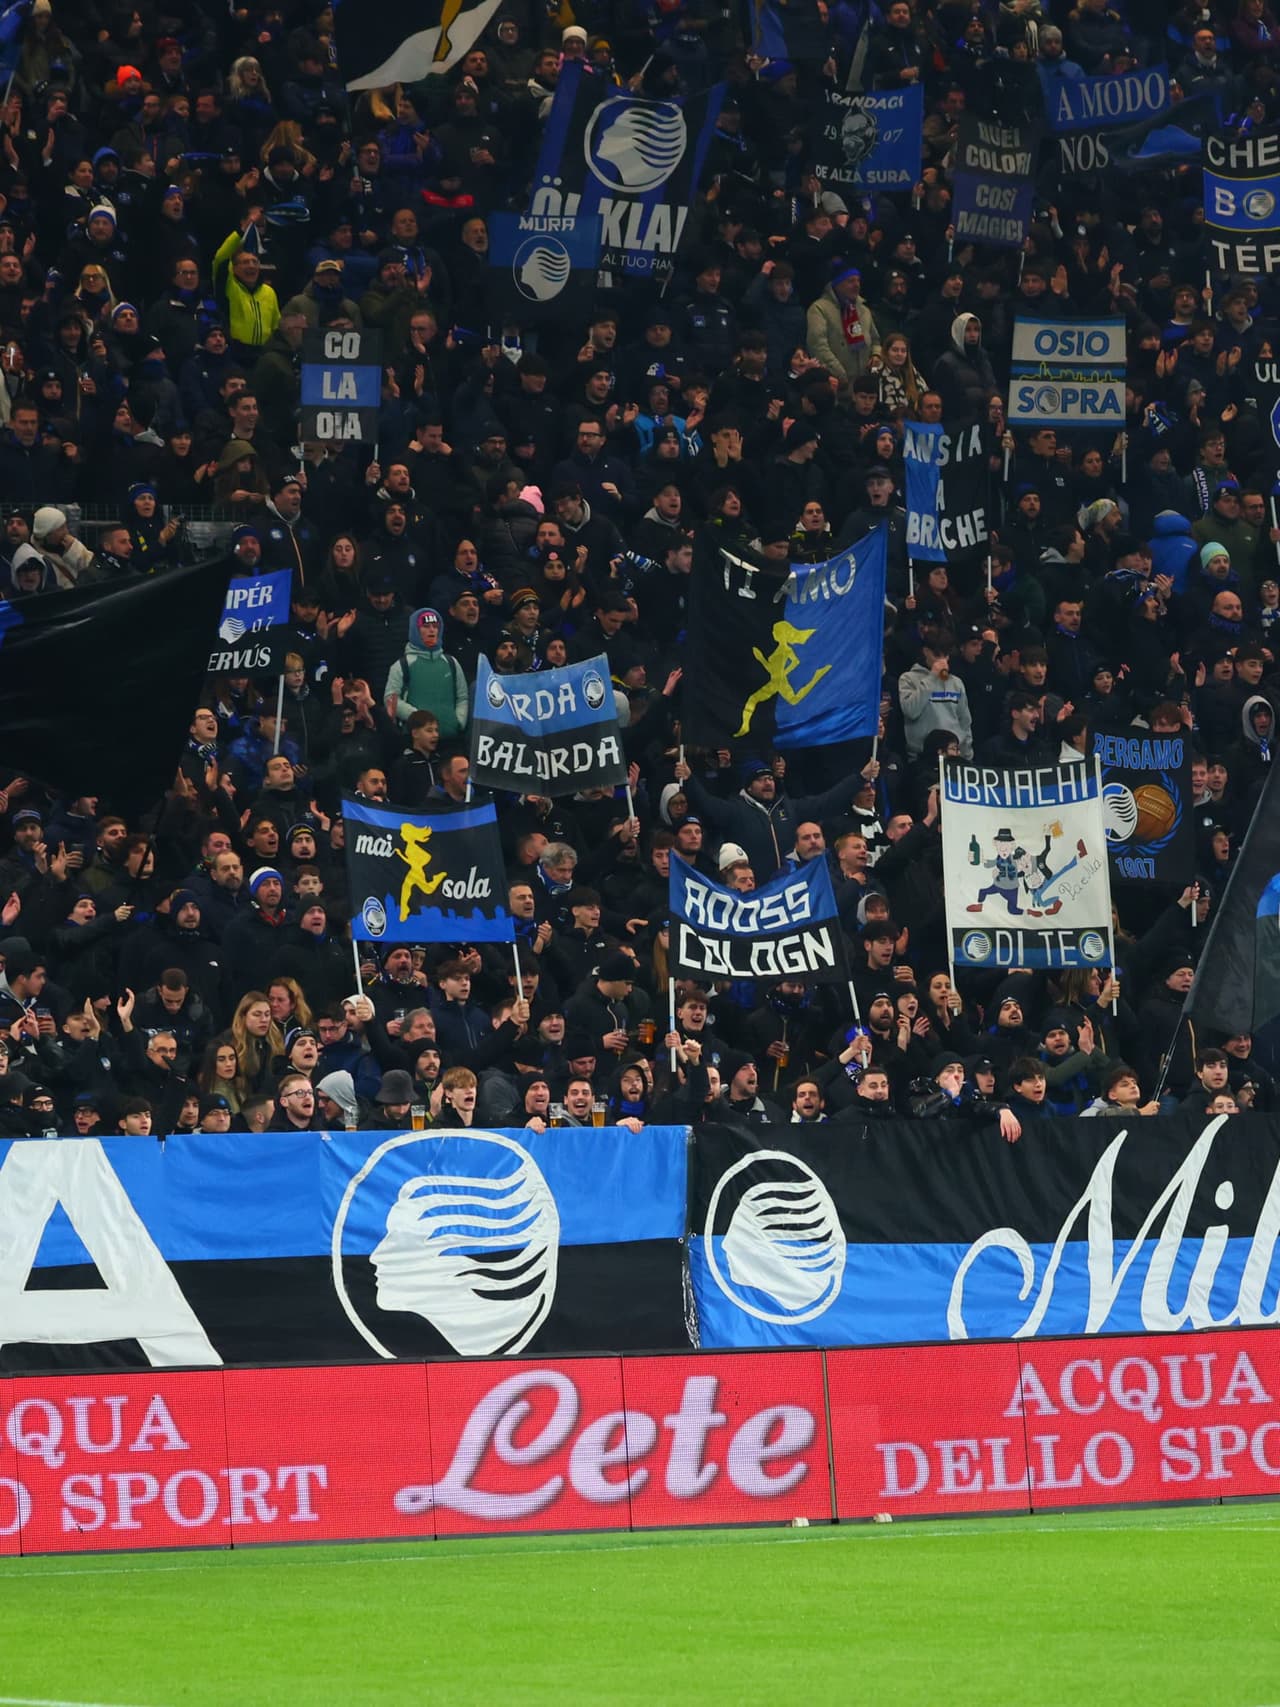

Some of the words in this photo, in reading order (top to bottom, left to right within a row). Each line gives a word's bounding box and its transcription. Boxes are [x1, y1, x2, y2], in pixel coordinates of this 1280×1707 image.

[1057, 86, 1074, 122] A
[1079, 72, 1167, 119] MODO
[866, 169, 911, 184] SURA
[965, 143, 1032, 176] COLORI
[518, 216, 576, 232] MURA
[955, 211, 1024, 244] MAGICI
[620, 255, 647, 269] TUO
[324, 331, 361, 360] CO
[1034, 329, 1110, 357] OSIO
[322, 371, 357, 400] LA
[903, 424, 982, 467] ANSIA
[936, 479, 946, 512] A
[772, 553, 856, 604] AMO
[476, 734, 621, 780] BALORDA
[1092, 732, 1184, 770] BERGAMO
[946, 763, 1089, 806] UBRIACHI
[355, 833, 395, 858] mai
[441, 865, 492, 900] sola
[1115, 858, 1156, 879] 1907
[995, 930, 1024, 966] DI
[1037, 930, 1078, 967] TE
[1003, 1351, 1273, 1422] ACQUA
[393, 1369, 817, 1521] Lete
[875, 1431, 1135, 1498] DELLO
[61, 1464, 329, 1533] SPORT
